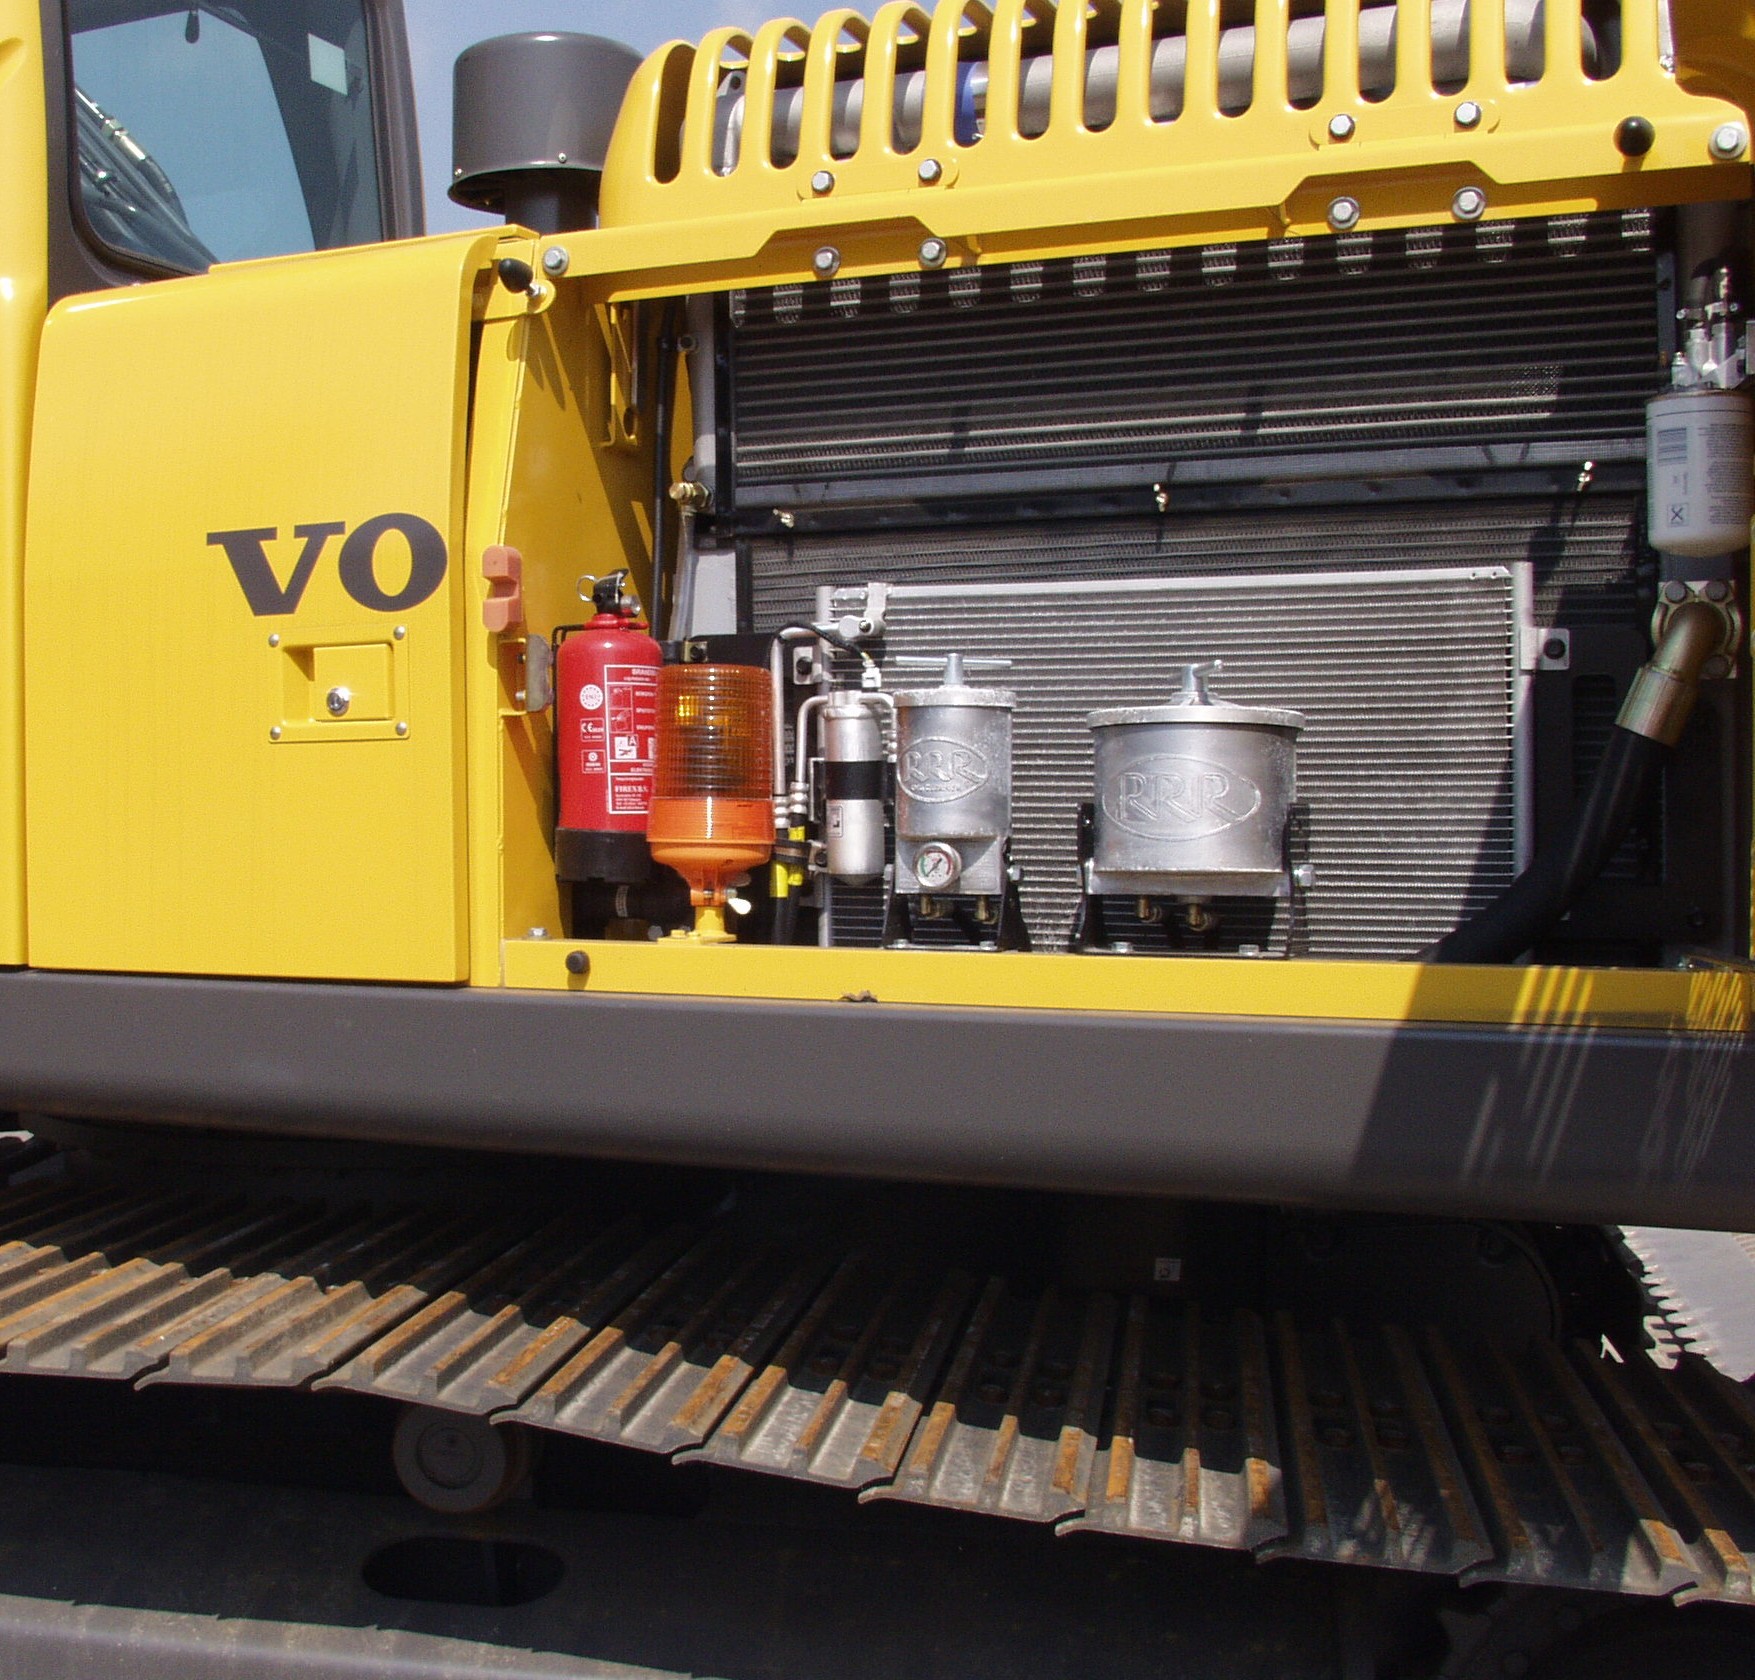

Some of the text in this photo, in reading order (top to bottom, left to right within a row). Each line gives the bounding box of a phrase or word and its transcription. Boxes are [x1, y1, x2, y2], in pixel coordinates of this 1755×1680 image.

[206, 513, 447, 617] VO
[904, 749, 984, 783] RRR
[1117, 771, 1242, 822] RRR
